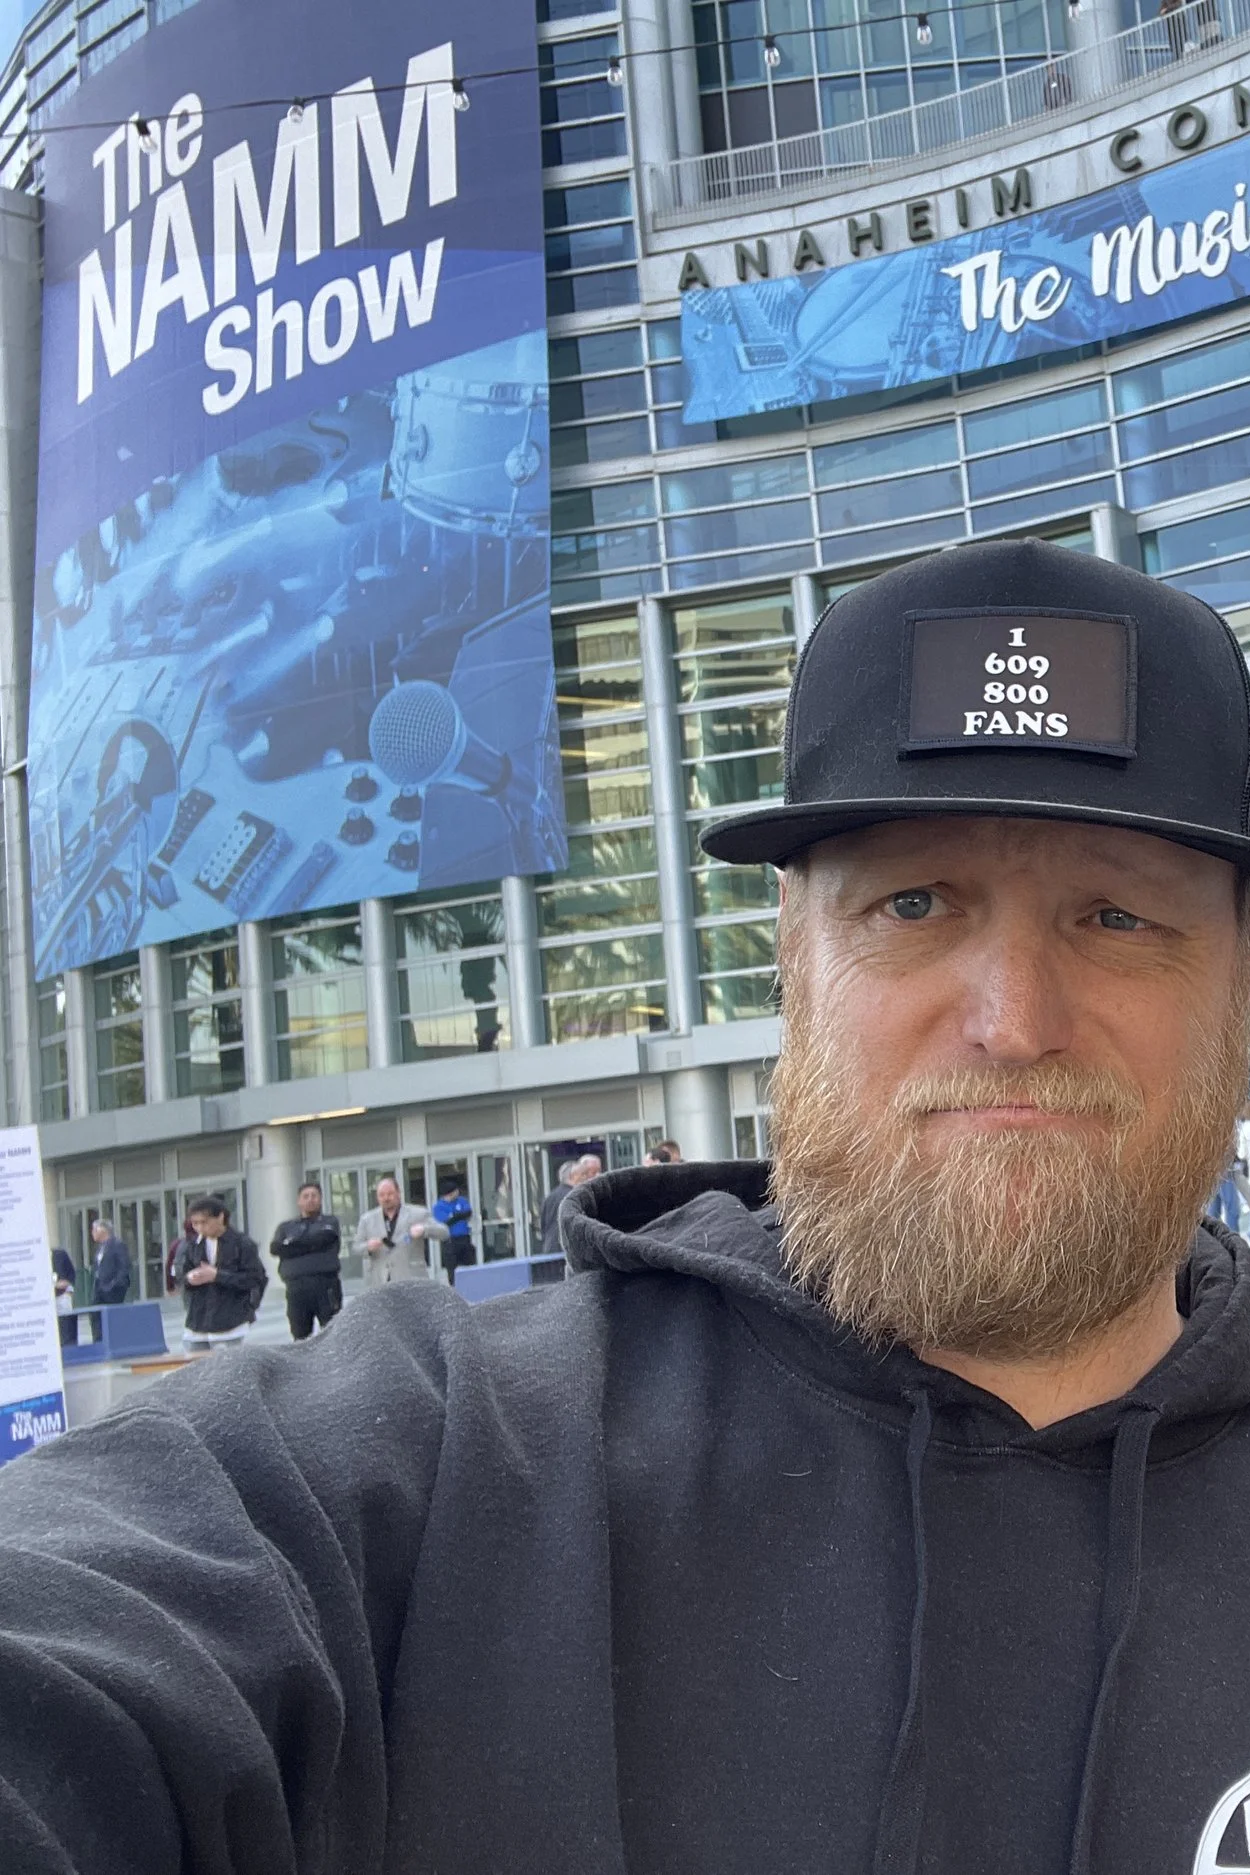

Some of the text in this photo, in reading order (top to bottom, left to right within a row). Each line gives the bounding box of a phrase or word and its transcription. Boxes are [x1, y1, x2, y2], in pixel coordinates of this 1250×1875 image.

[92, 92, 203, 233] The
[77, 41, 457, 405] NAMM
[678, 167, 1033, 291] ANAHEIM
[941, 249, 1071, 333] The
[201, 237, 445, 416] Show
[1008, 627, 1027, 647] 1
[983, 682, 1049, 705] 800
[985, 653, 1050, 679] 609
[963, 710, 1069, 737] FANS
[11, 1411, 61, 1441] NAMM
